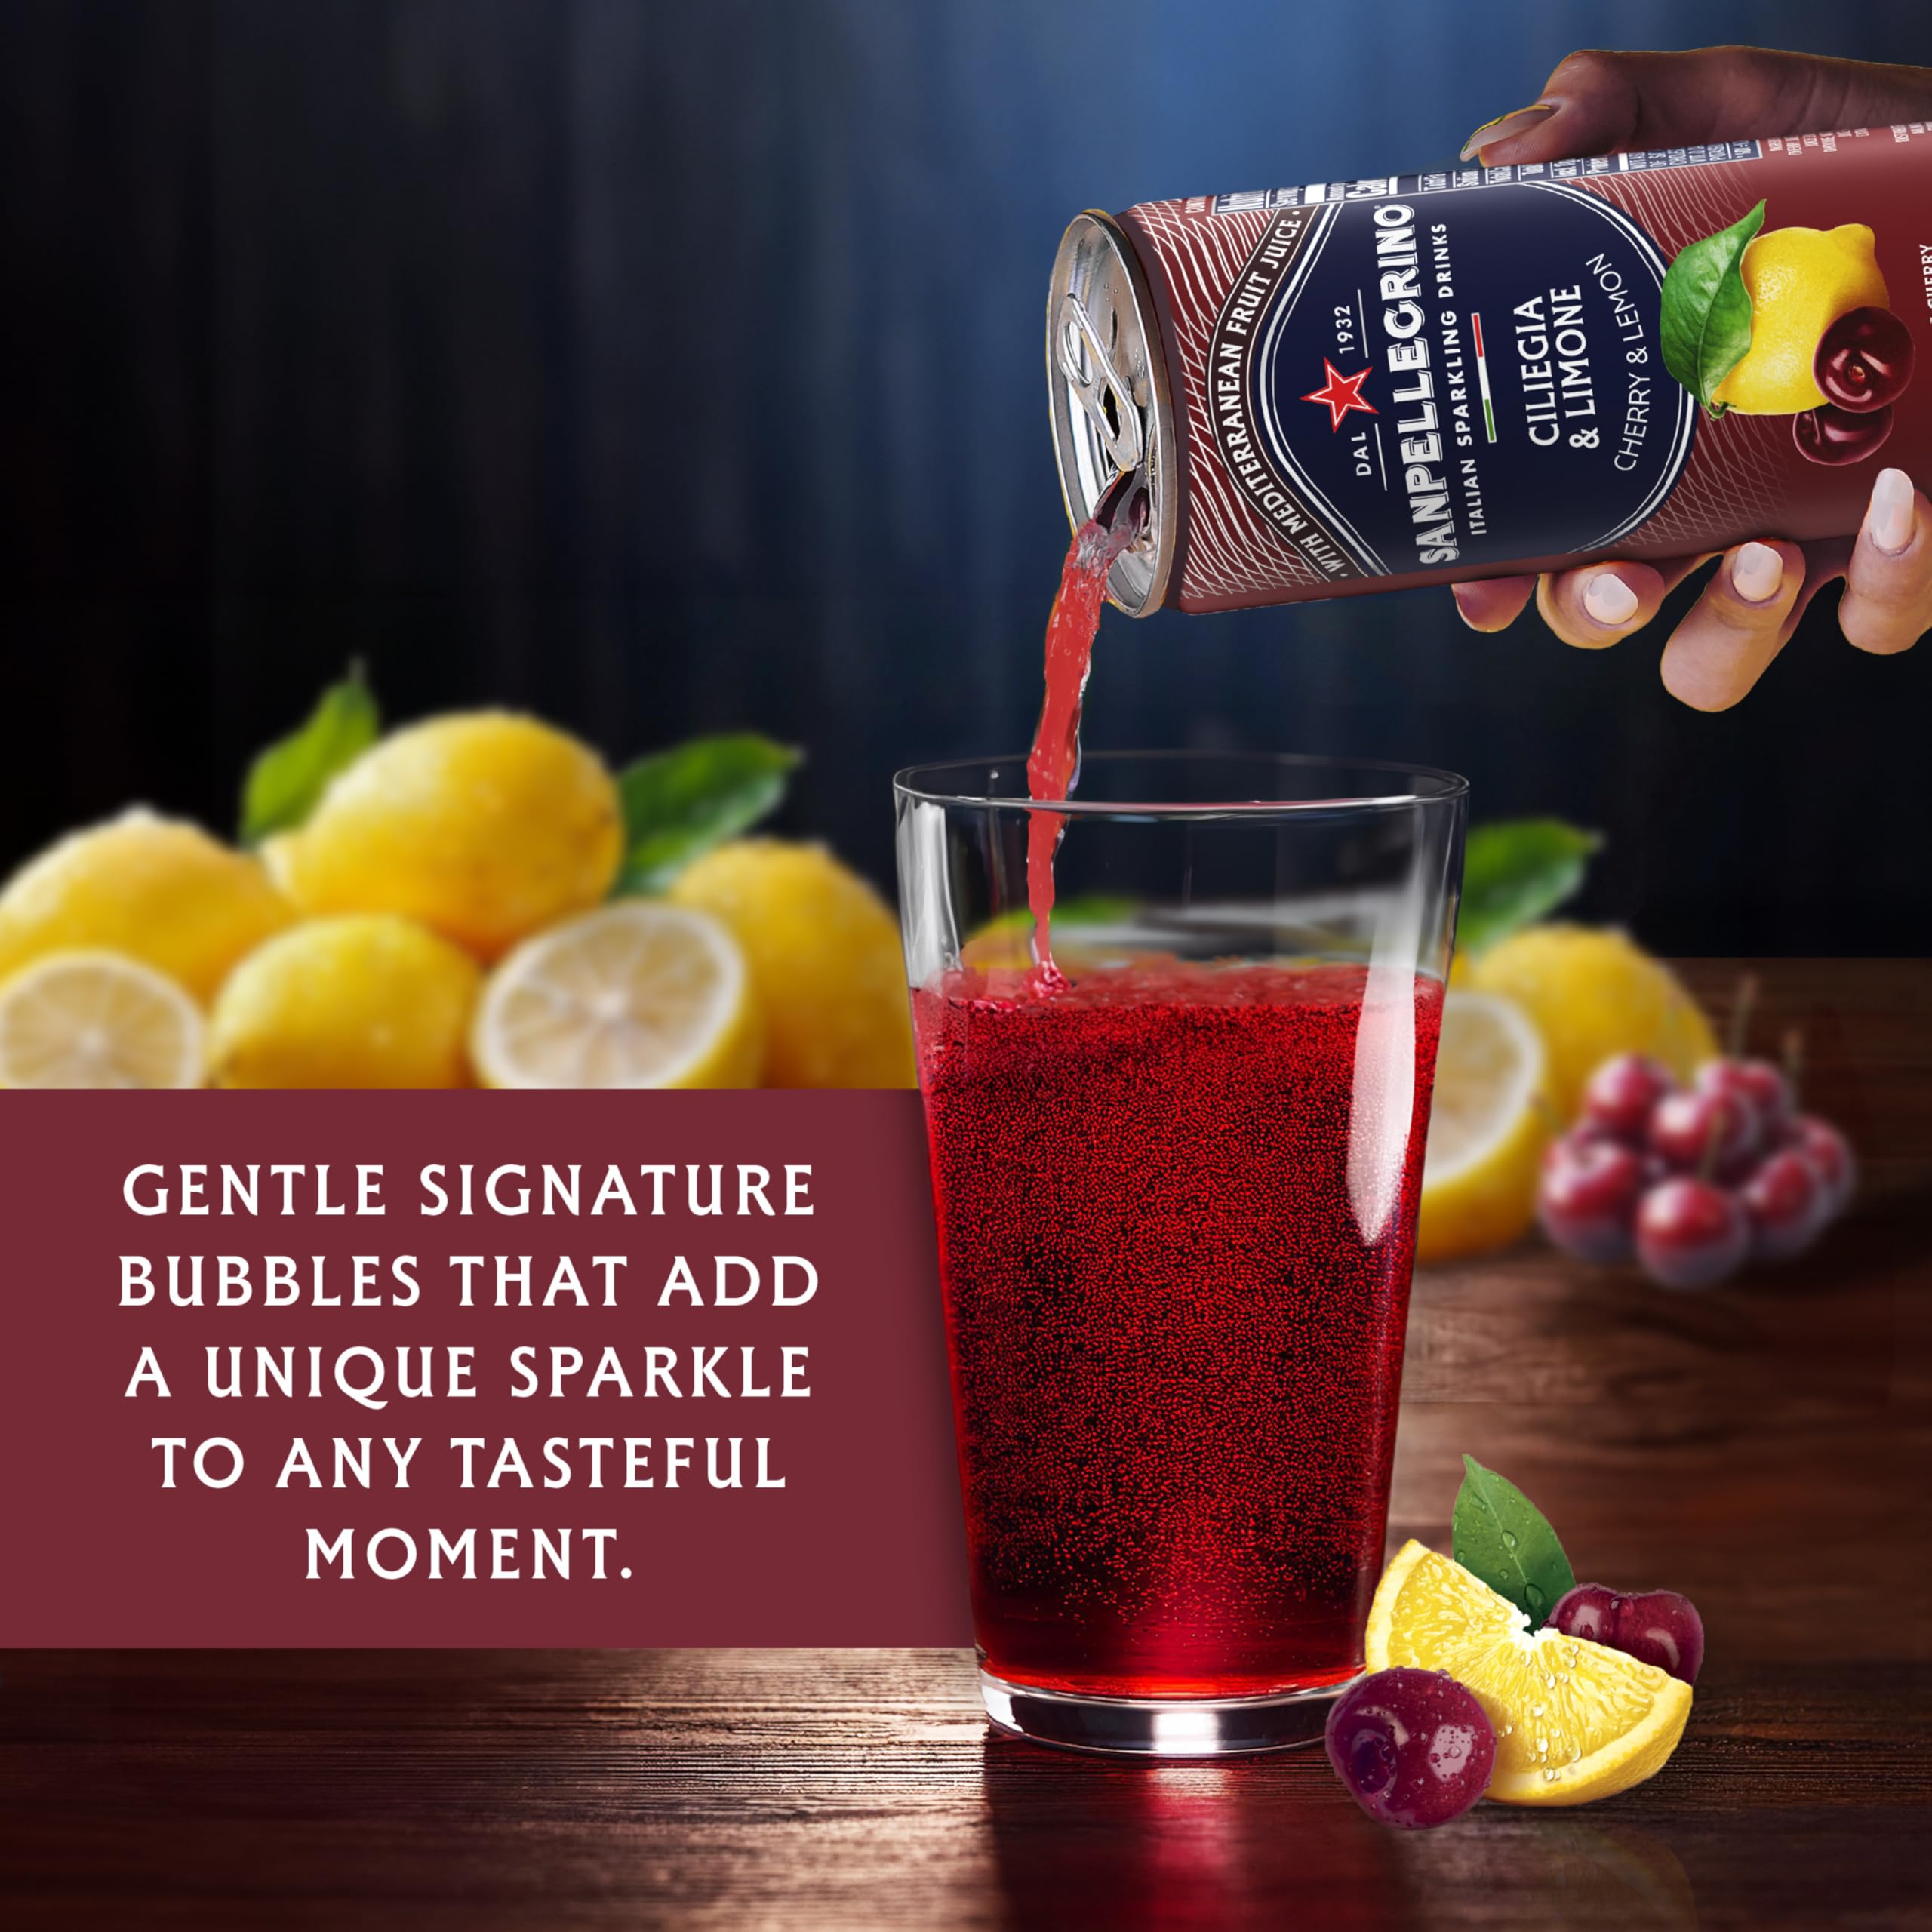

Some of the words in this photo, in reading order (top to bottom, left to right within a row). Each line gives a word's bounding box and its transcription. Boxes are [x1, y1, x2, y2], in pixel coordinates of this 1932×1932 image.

[1260, 219, 1301, 275] JUICE
[1431, 223, 1454, 298] DRINKS
[1229, 272, 1263, 336] FRUIT
[1334, 305, 1355, 354] 1932
[1585, 253, 1644, 342] LEMON
[1373, 205, 1460, 565] SANPELLEGRINO
[1441, 310, 1472, 446] SPARKLING
[1513, 295, 1559, 447] CILIEGIA
[1550, 284, 1596, 419] LIMONE
[1626, 346, 1648, 364] &
[1218, 342, 1307, 540] MEDITERRANEAN
[1352, 432, 1372, 477] DAL
[1568, 427, 1600, 449] &
[1614, 372, 1651, 471] CHERRY
[1461, 459, 1487, 535] ITALIAN
[1300, 533, 1337, 574] WITH
